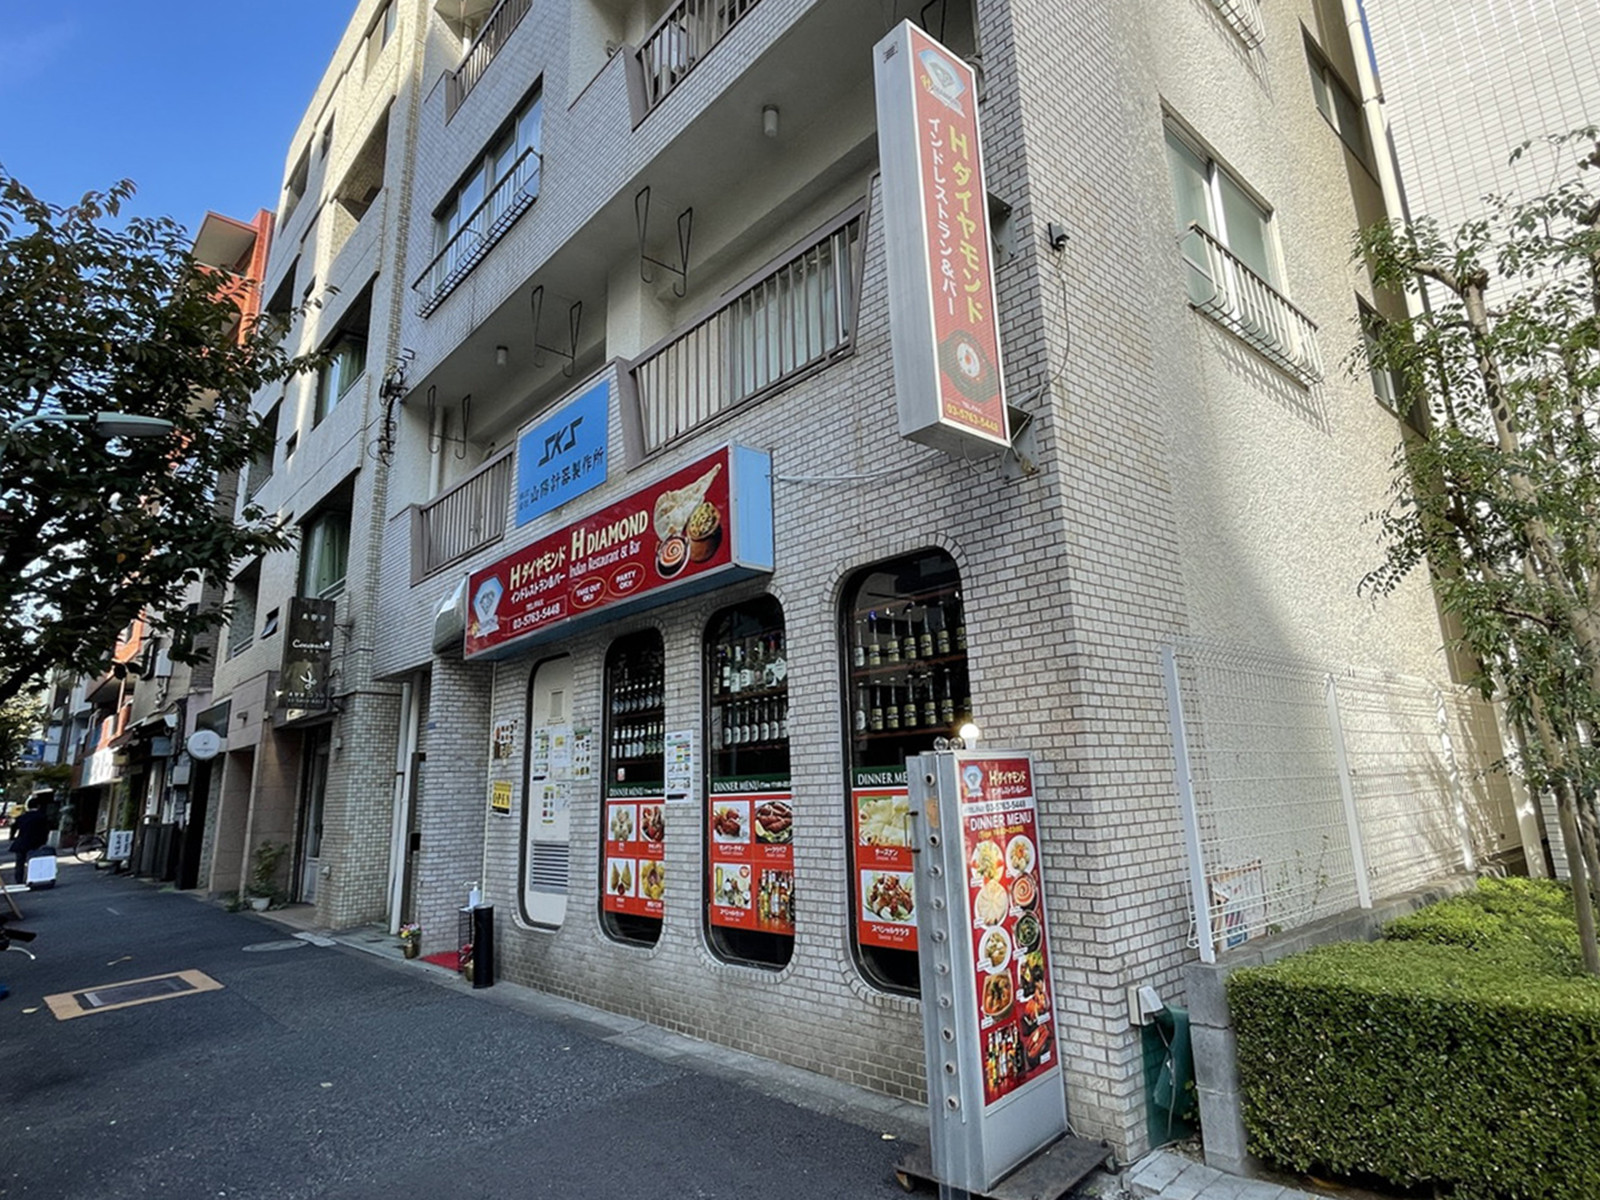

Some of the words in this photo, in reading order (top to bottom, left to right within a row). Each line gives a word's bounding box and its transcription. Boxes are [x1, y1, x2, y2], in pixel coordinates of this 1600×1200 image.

[928, 118, 957, 316] インドレストラン&バー
[537, 415, 584, 468] SKS
[586, 509, 650, 556] DIAMOND
[509, 545, 566, 591] Hダイヤモンド
[569, 560, 588, 579] Indian
[588, 548, 620, 572] Restaurant
[620, 547, 629, 560] &
[629, 540, 642, 556] Bar
[575, 586, 589, 598] TAKE
[589, 582, 602, 593] OUT
[615, 570, 637, 583] PARTY
[512, 603, 561, 630] 03-5763-5448
[713, 781, 738, 792] DINNER
[738, 780, 759, 791] MENU
[857, 772, 893, 785] DINNER
[970, 813, 1005, 831] DINNER
[1006, 811, 1032, 826] MENU
